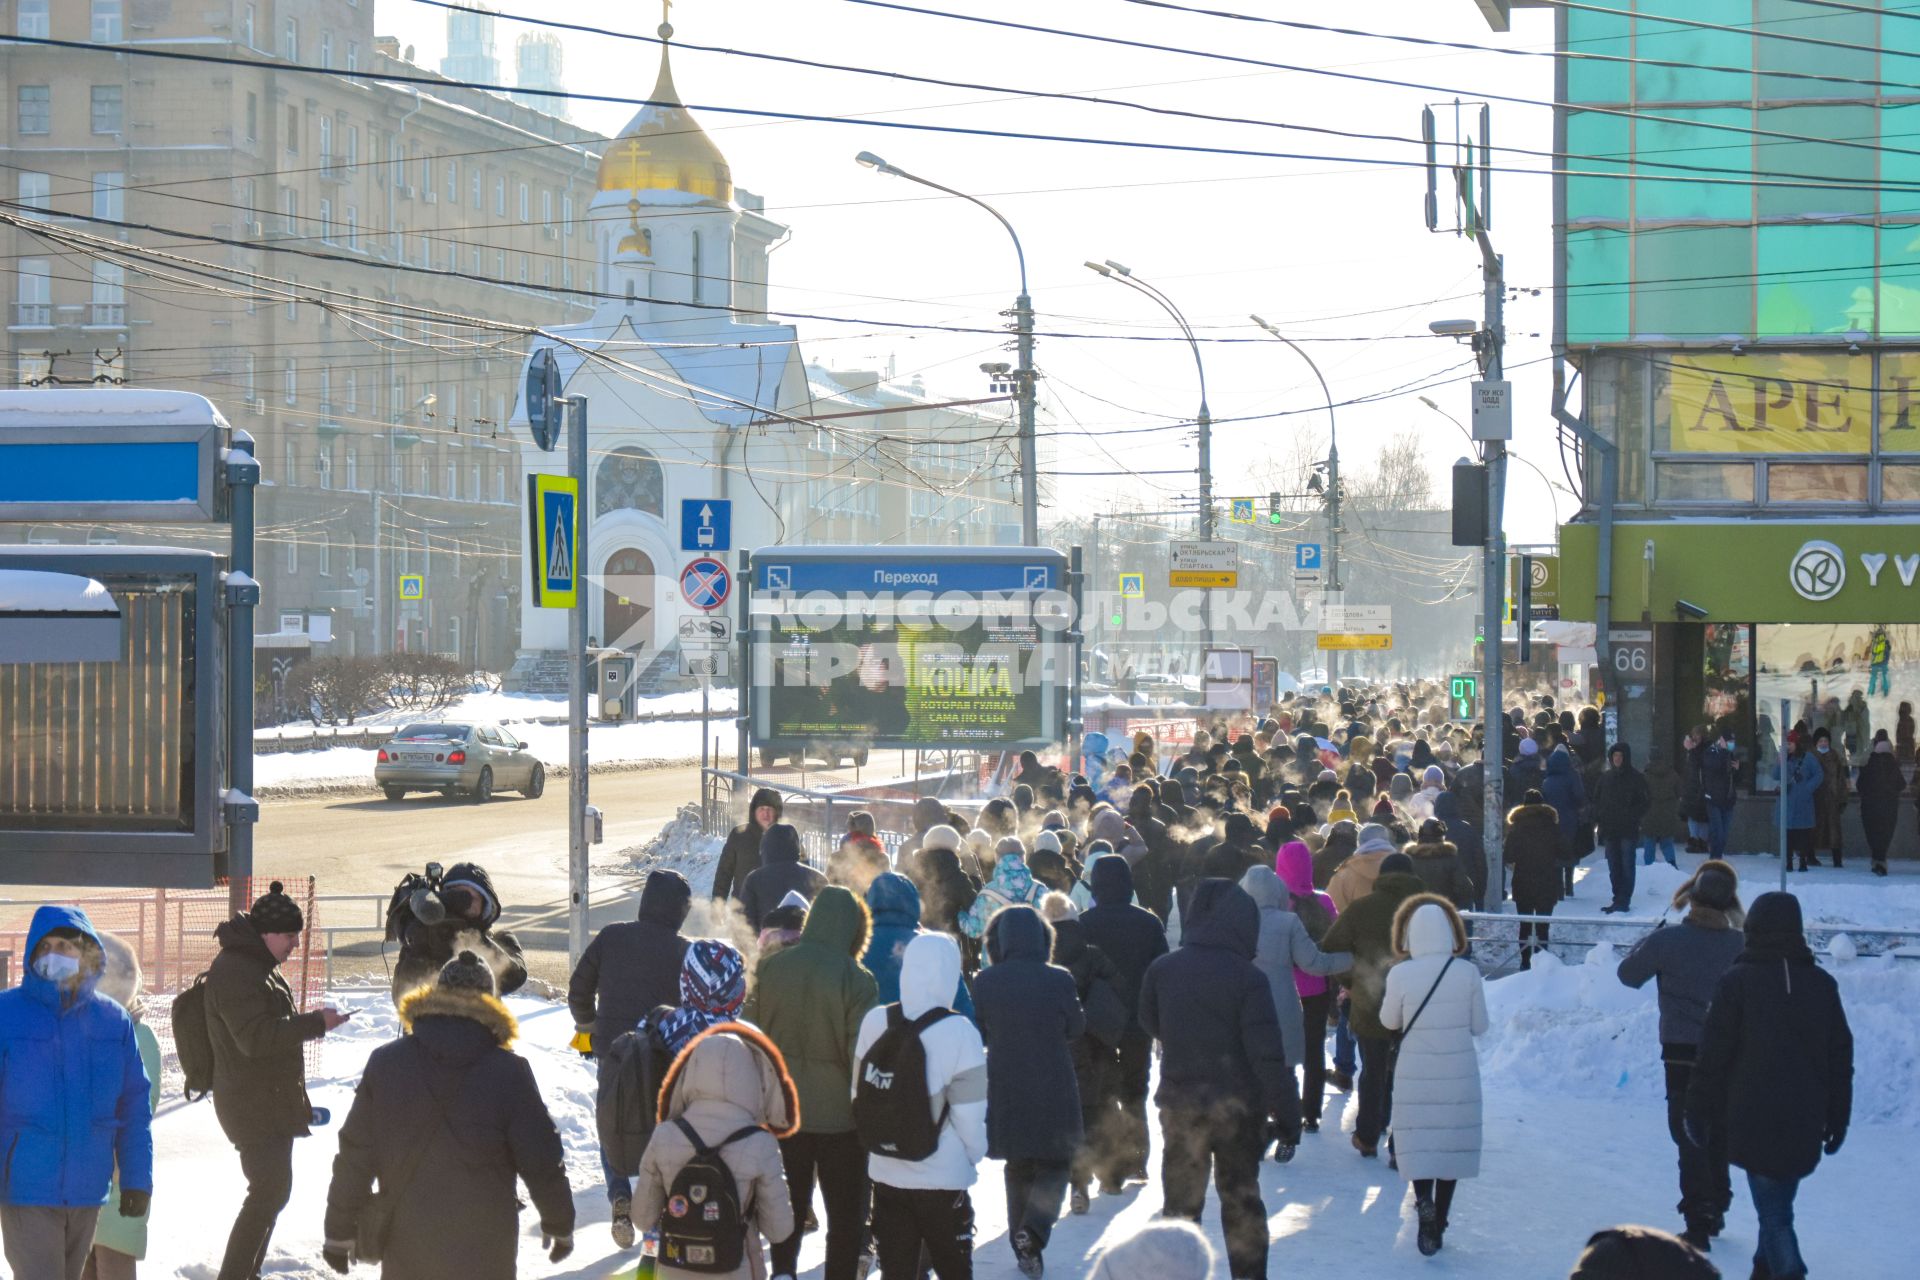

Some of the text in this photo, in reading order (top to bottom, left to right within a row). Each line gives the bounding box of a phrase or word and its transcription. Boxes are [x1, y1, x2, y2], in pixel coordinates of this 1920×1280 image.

[874, 570, 938, 586] Переход
[1615, 648, 1646, 671] 66
[921, 667, 1016, 699] КОШКА,
[1453, 679, 1475, 697] 07
[920, 701, 1016, 710] КОТОРАЯ ГУЛЯЛА
[929, 713, 1007, 723] САМА ПО СЕБЕ
